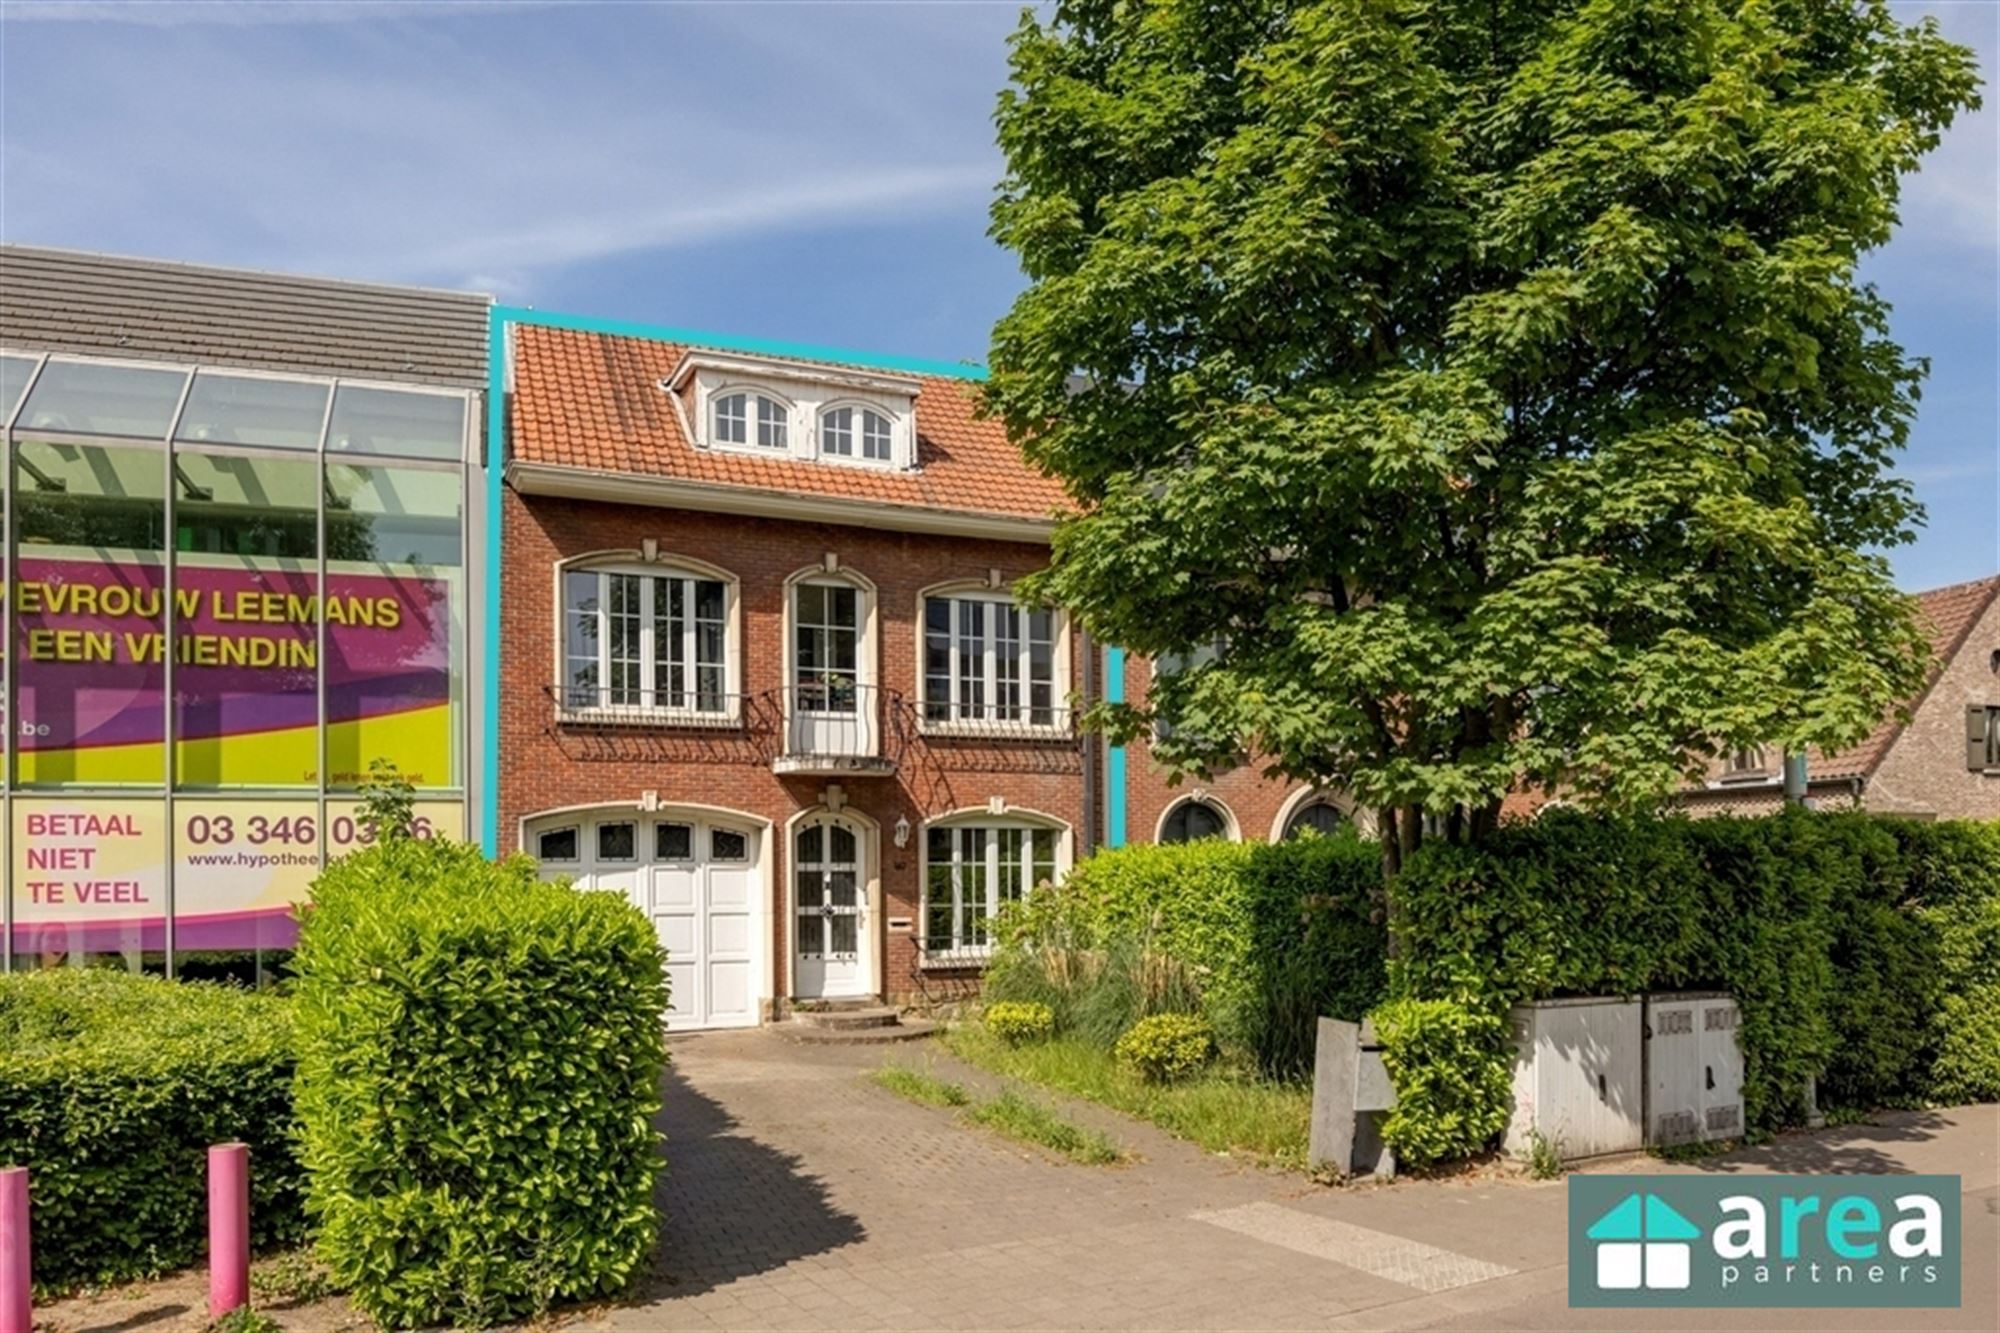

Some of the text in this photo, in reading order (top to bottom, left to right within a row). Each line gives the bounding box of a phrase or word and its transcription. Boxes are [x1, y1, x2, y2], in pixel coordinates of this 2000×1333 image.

[0, 581, 400, 627] EVROUW LEEMANS
[29, 629, 112, 661] EEN
[27, 814, 142, 836] BETAAL
[187, 815, 234, 845] 03
[247, 816, 316, 845] 346
[27, 848, 96, 870] NIET
[26, 882, 149, 903] TE VEEL
